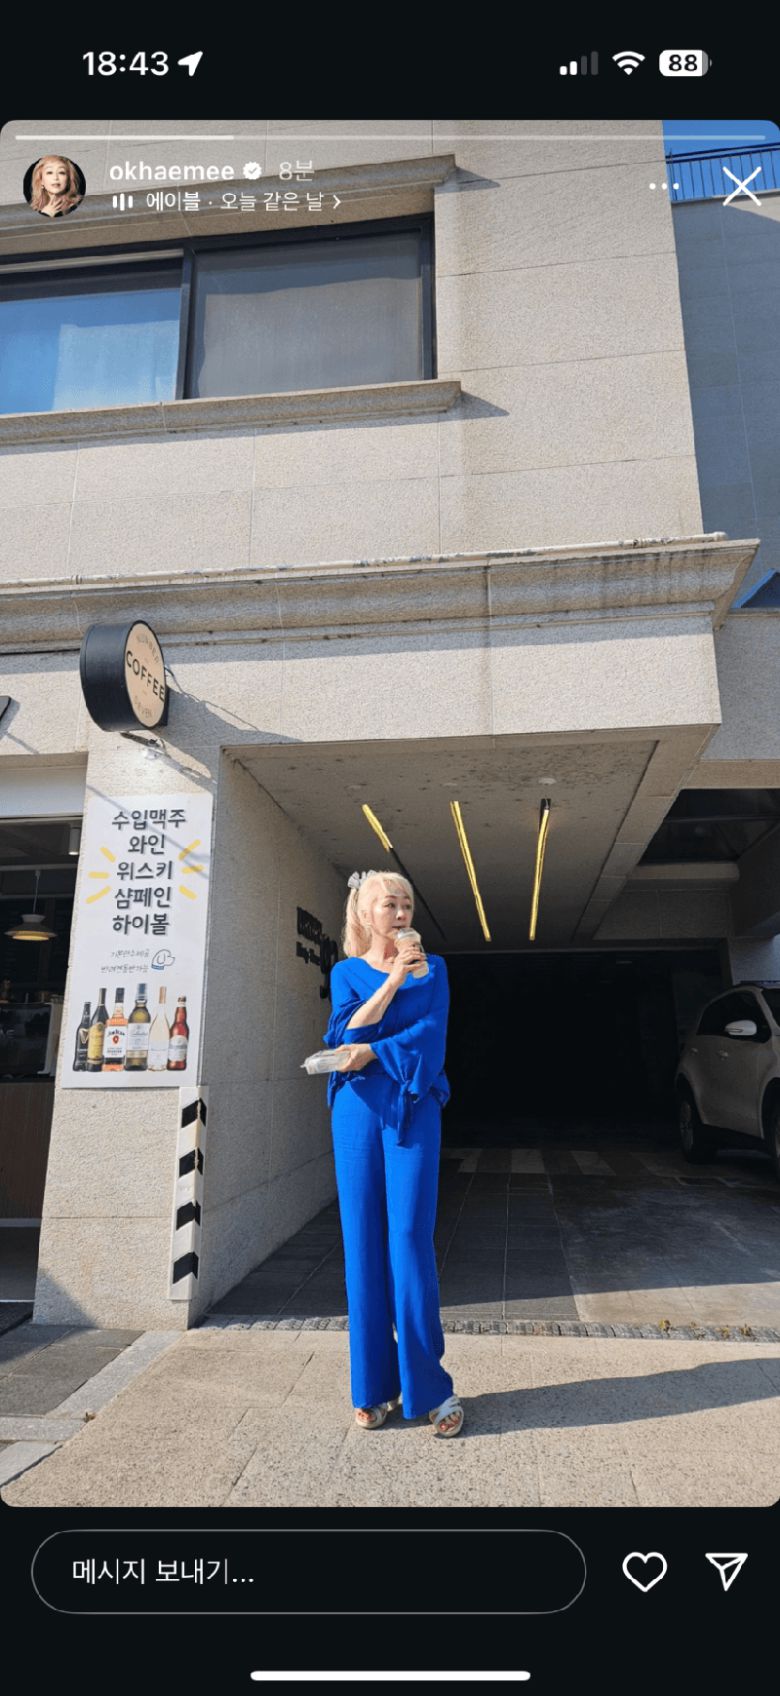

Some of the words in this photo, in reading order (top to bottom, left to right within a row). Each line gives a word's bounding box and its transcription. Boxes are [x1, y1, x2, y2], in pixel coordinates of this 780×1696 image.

[126, 650, 165, 703] COFFEE
[111, 808, 187, 831] 수입맥주
[127, 834, 166, 856] 와인
[116, 860, 174, 881] 위스키
[114, 886, 172, 910] 샴페인
[111, 912, 170, 936] 하이볼
